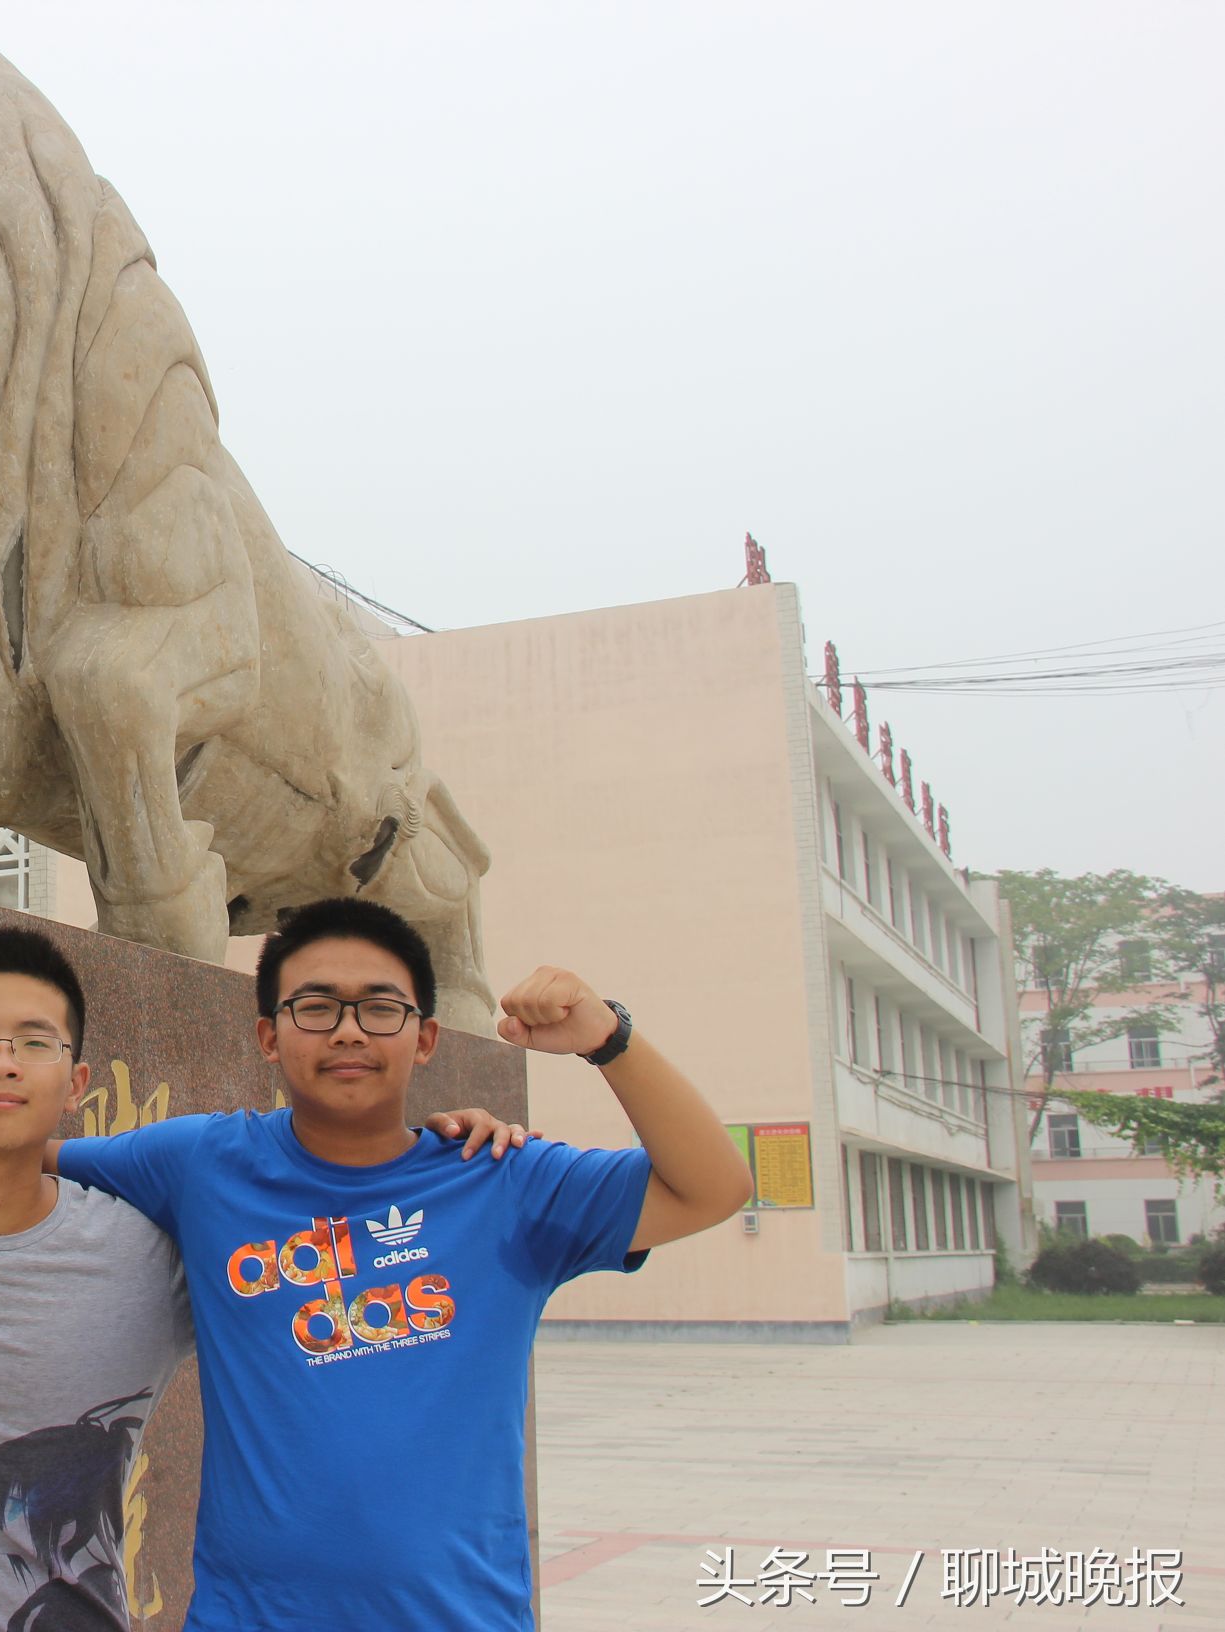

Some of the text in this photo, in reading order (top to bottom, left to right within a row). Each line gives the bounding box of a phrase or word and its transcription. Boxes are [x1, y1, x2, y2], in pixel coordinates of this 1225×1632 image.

[373, 1247, 429, 1268] adidas
[292, 1274, 455, 1355] das
[306, 1329, 451, 1367] THE BRAND WITH THE THREE STRIPES
